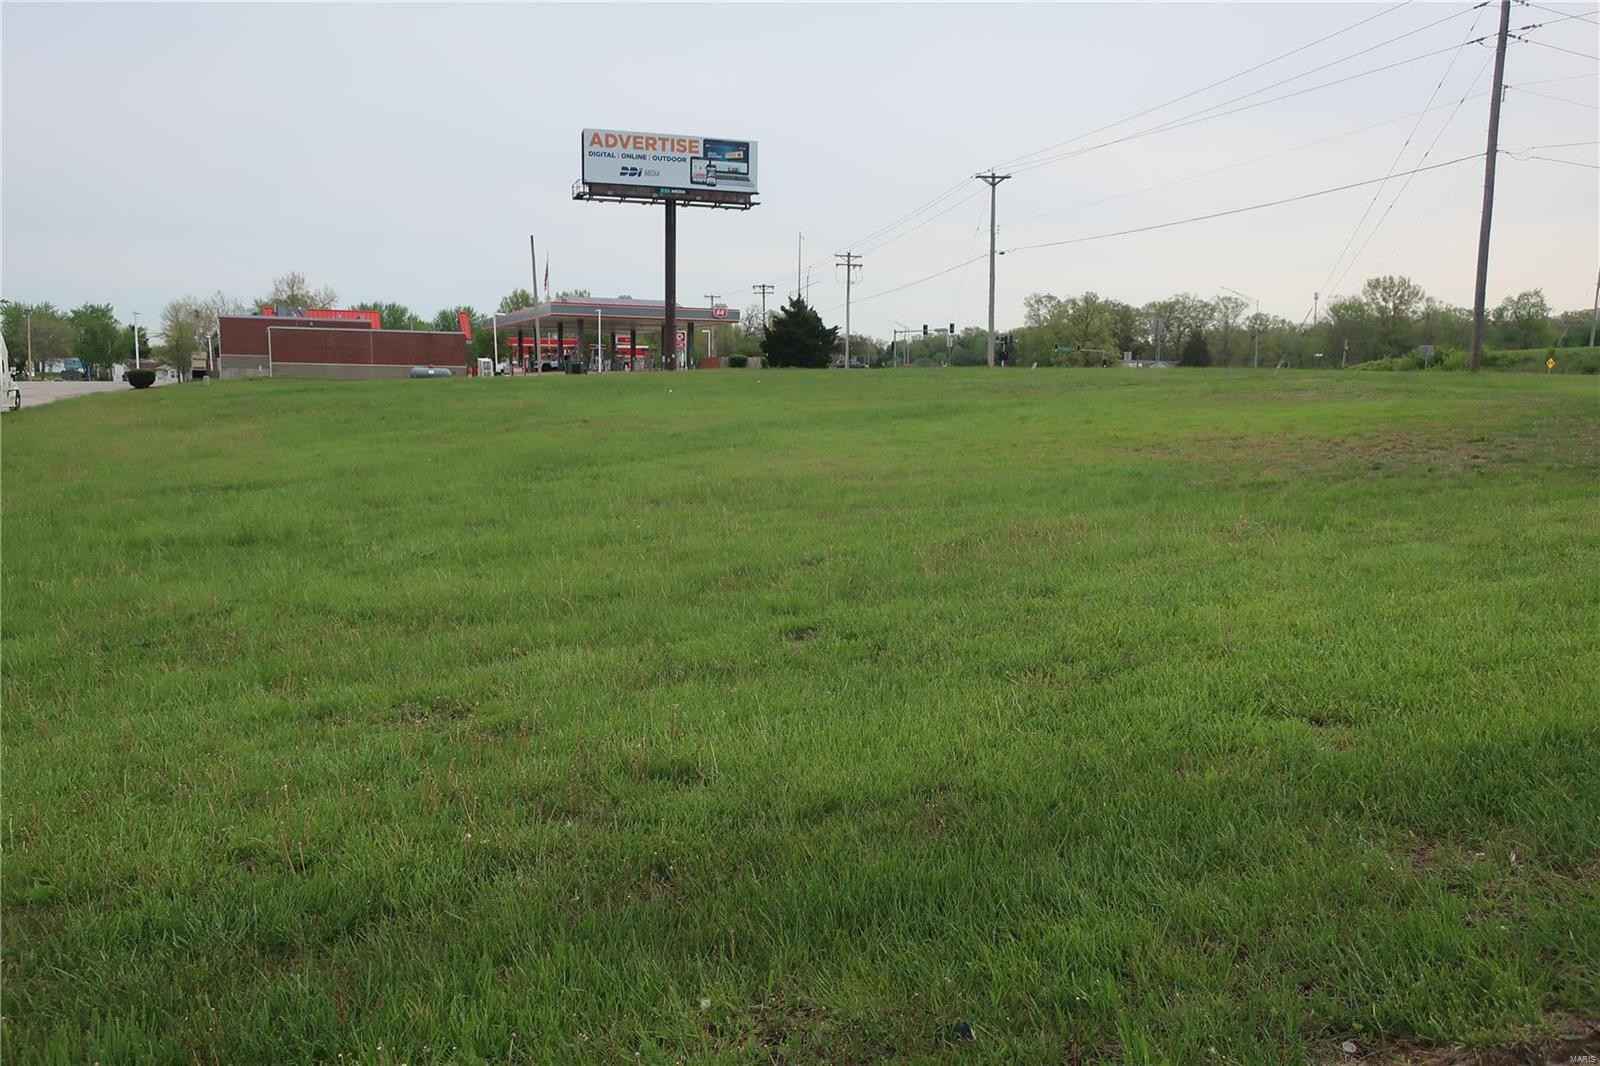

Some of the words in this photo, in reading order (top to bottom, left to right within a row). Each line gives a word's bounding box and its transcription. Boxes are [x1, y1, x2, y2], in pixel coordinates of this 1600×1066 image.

[590, 132, 699, 154] ADVERTISE
[588, 150, 616, 159] DIGITAL
[621, 152, 647, 160] ONLINE
[652, 154, 687, 162] OUTDOOR
